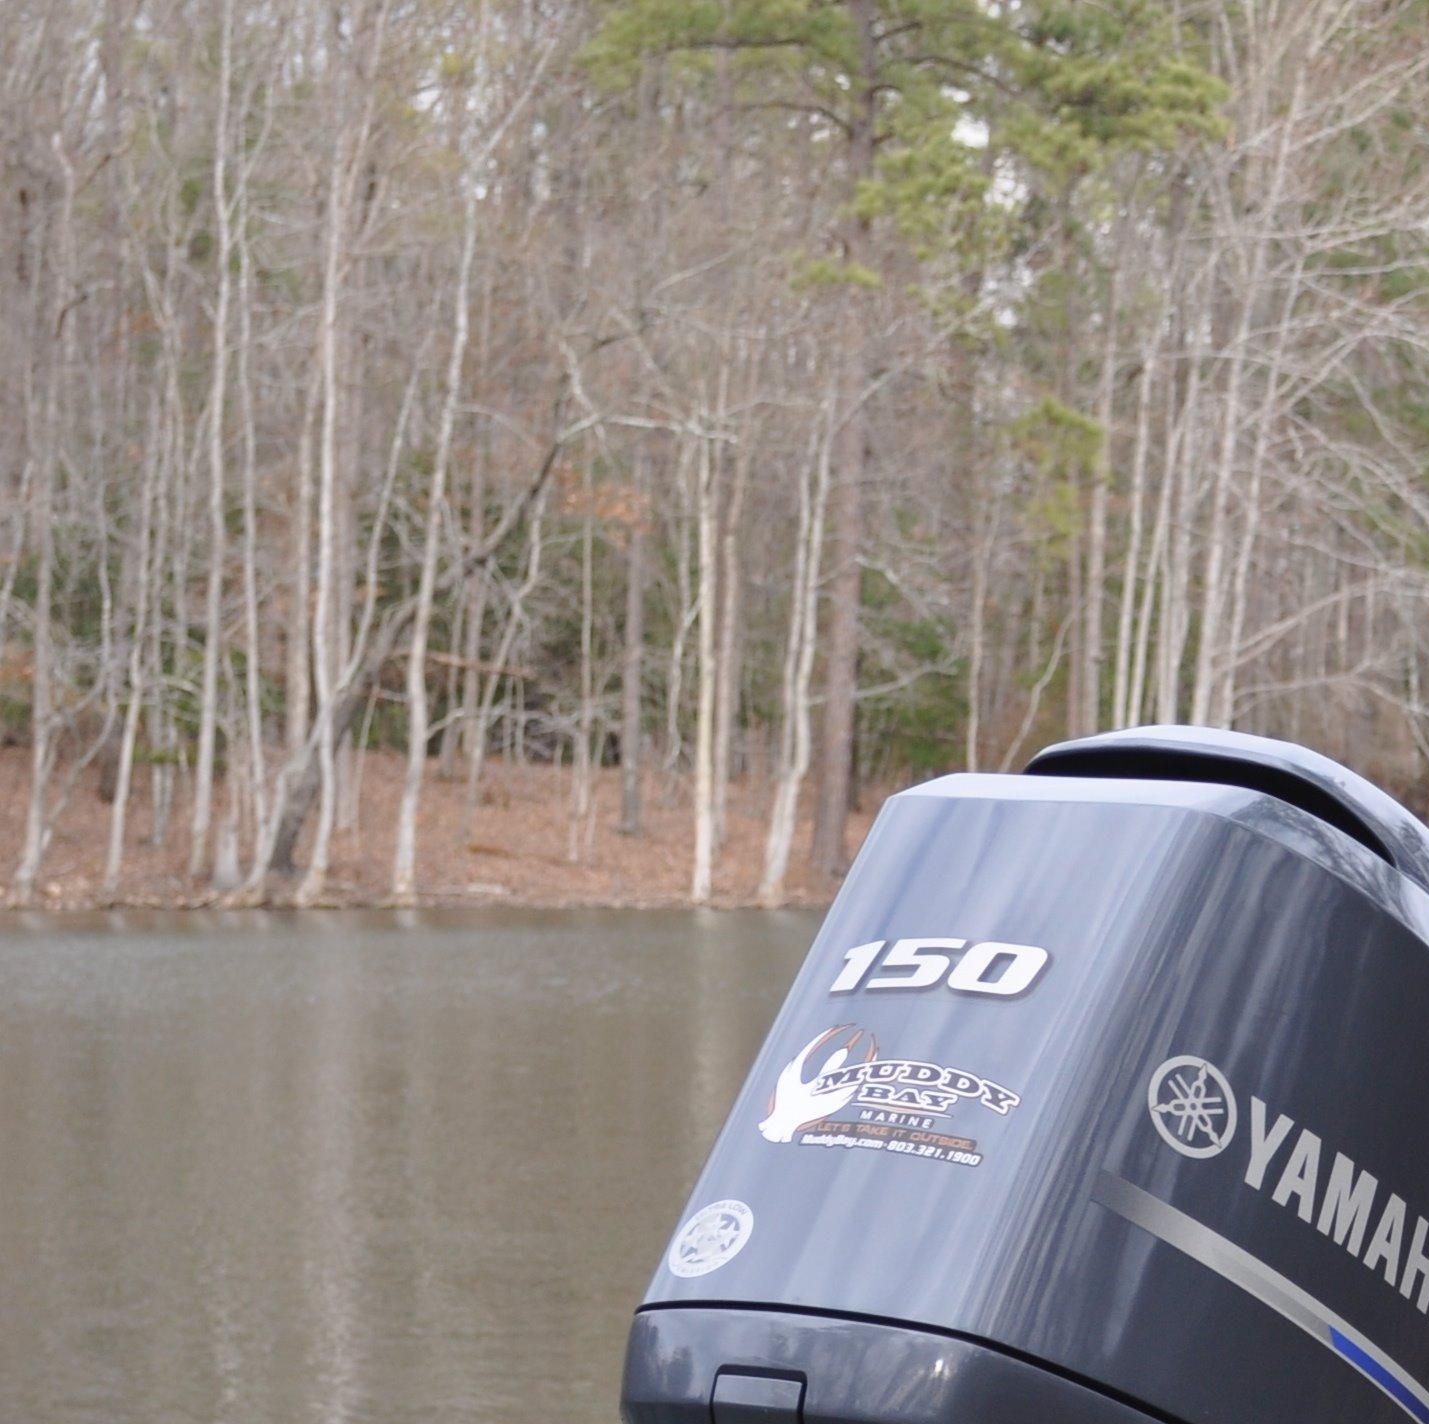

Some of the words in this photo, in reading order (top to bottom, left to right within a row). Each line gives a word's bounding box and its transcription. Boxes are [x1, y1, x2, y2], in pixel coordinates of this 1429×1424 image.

[829, 937, 1050, 995] 150
[811, 1060, 1020, 1115] MUDDY
[858, 1083, 958, 1112] BAY
[856, 1123, 889, 1137] TAKE
[892, 1128, 906, 1139] IT
[860, 1110, 933, 1129] MARINE
